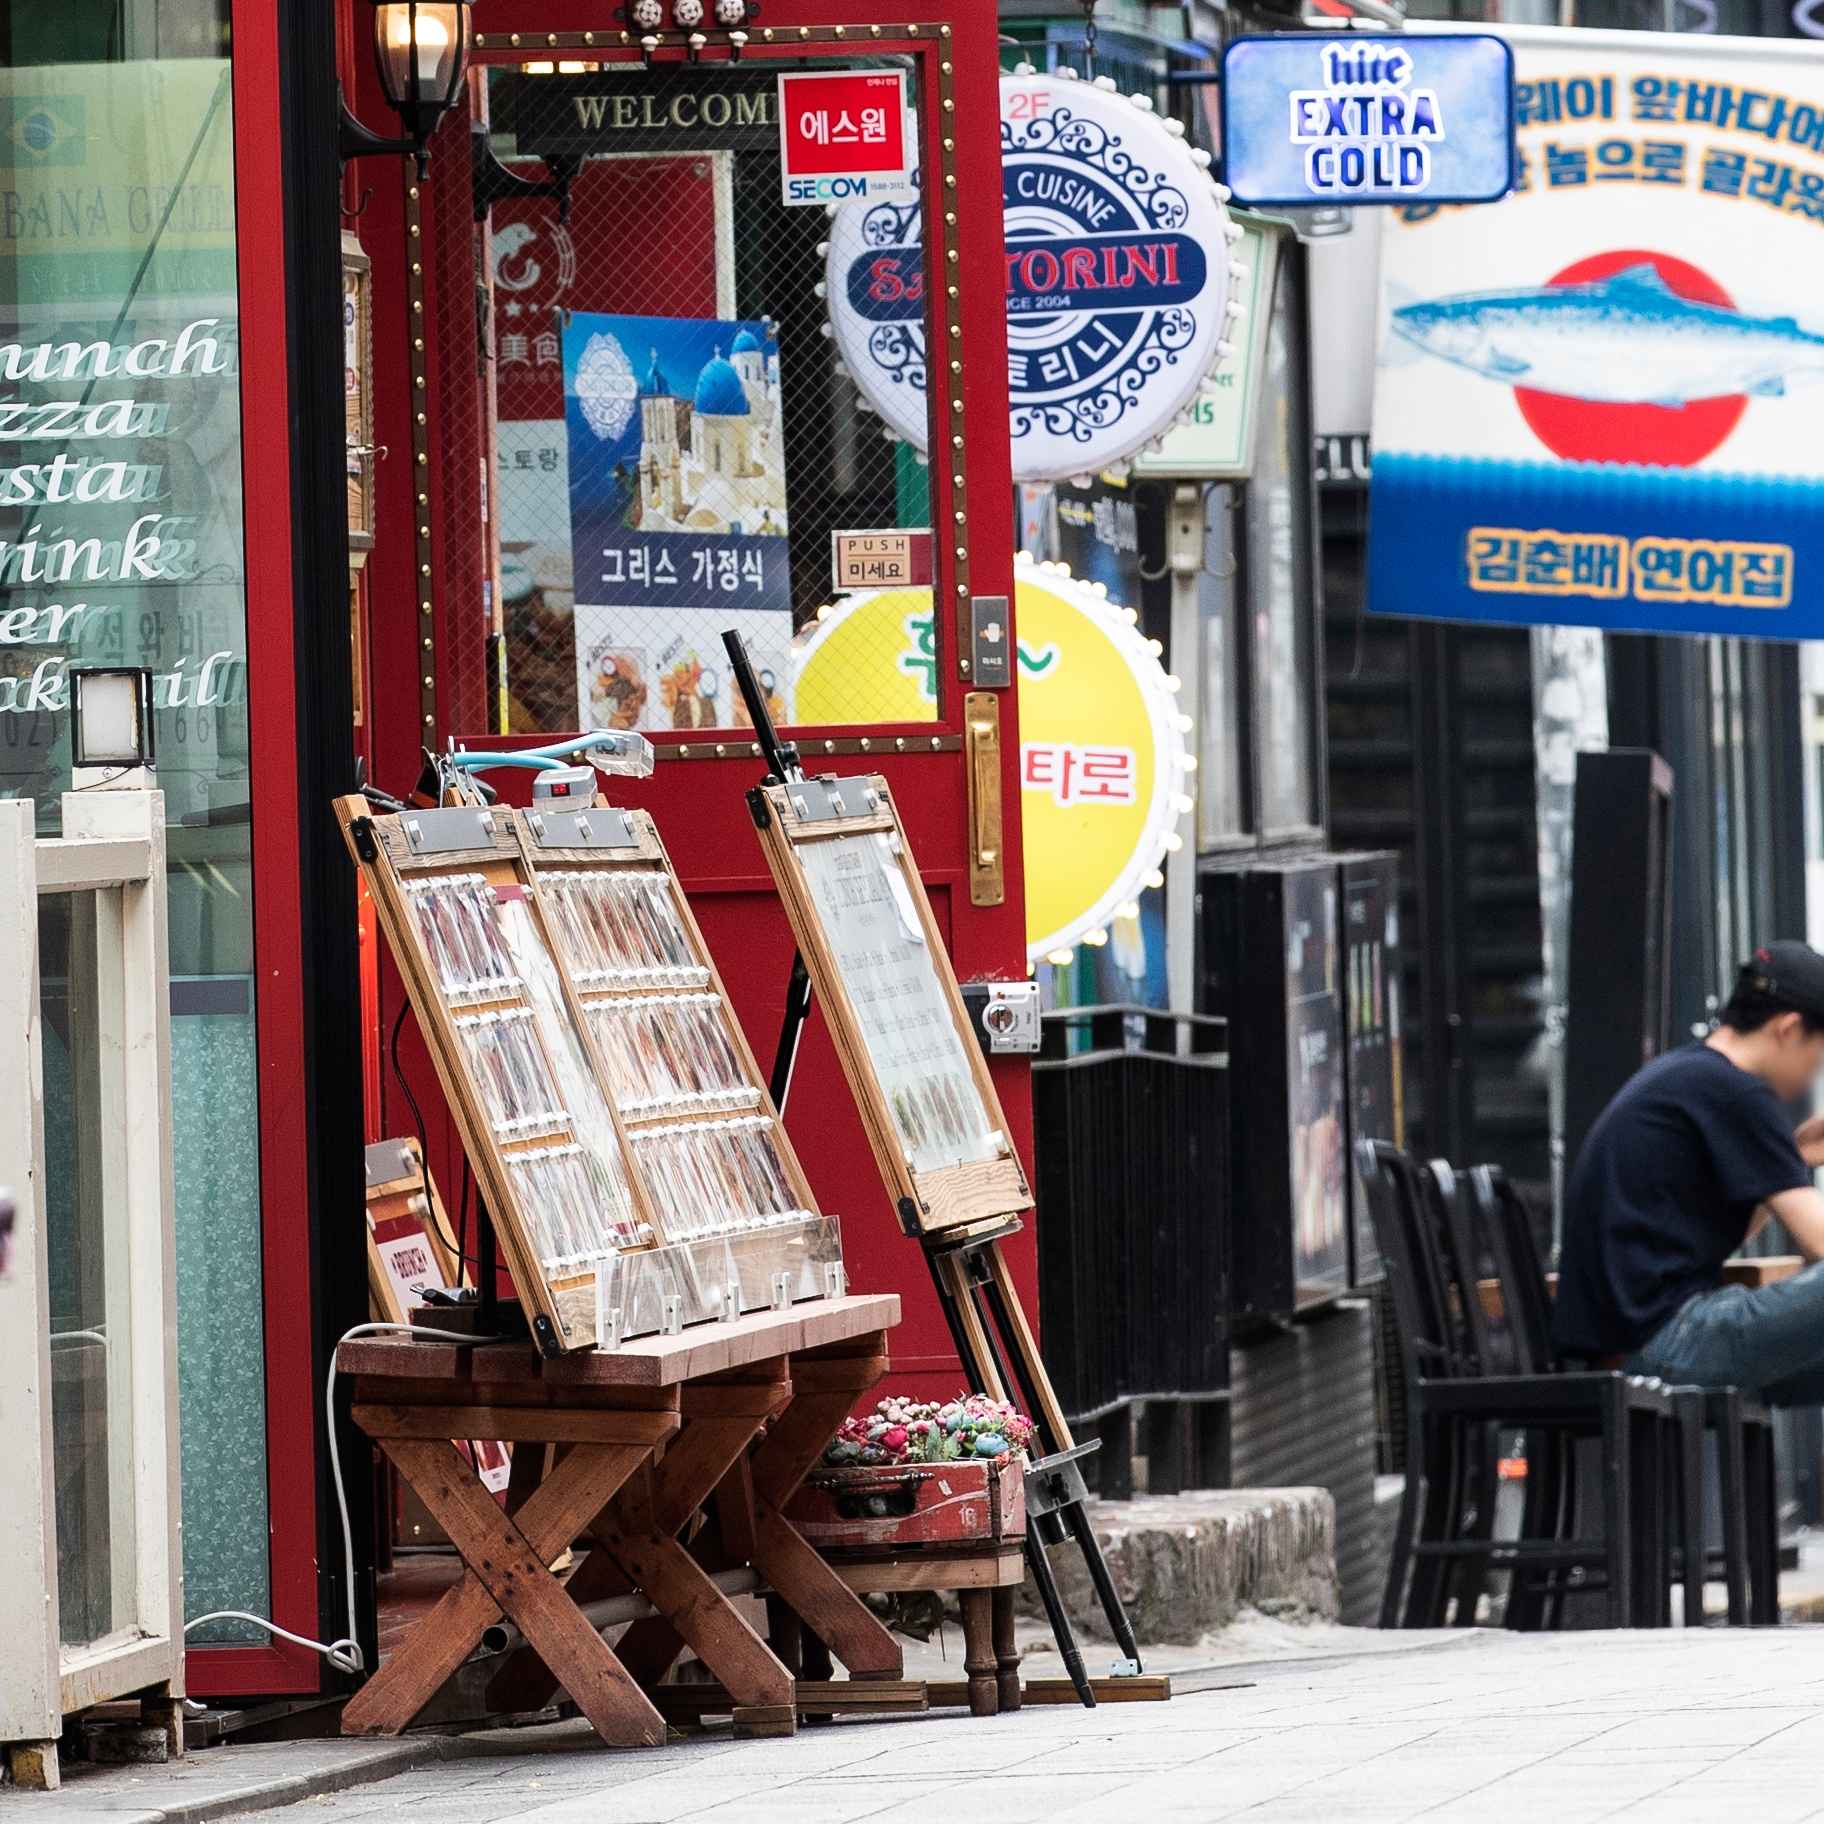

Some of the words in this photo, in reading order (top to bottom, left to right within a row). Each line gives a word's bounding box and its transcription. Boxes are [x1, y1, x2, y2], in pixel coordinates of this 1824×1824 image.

[1328, 49, 1406, 86] hite
[1008, 93, 1052, 120] 2F
[1297, 95, 1438, 136] EXTRA
[800, 107, 887, 145] 에스원
[1312, 146, 1424, 187] COLD
[1544, 139, 1686, 188] 놈으로
[789, 177, 867, 199] SECOM
[1017, 171, 1117, 229] CUISINE
[1035, 295, 1071, 309] 2004
[499, 332, 560, 367] 美食
[849, 538, 906, 552] PUSH
[601, 546, 678, 588] 그리스
[692, 547, 764, 592] 가정식
[849, 560, 904, 579] 미세요
[1470, 530, 1625, 595] 김춘배
[1635, 539, 1791, 605] 연어집
[1025, 749, 1130, 800] 타로
